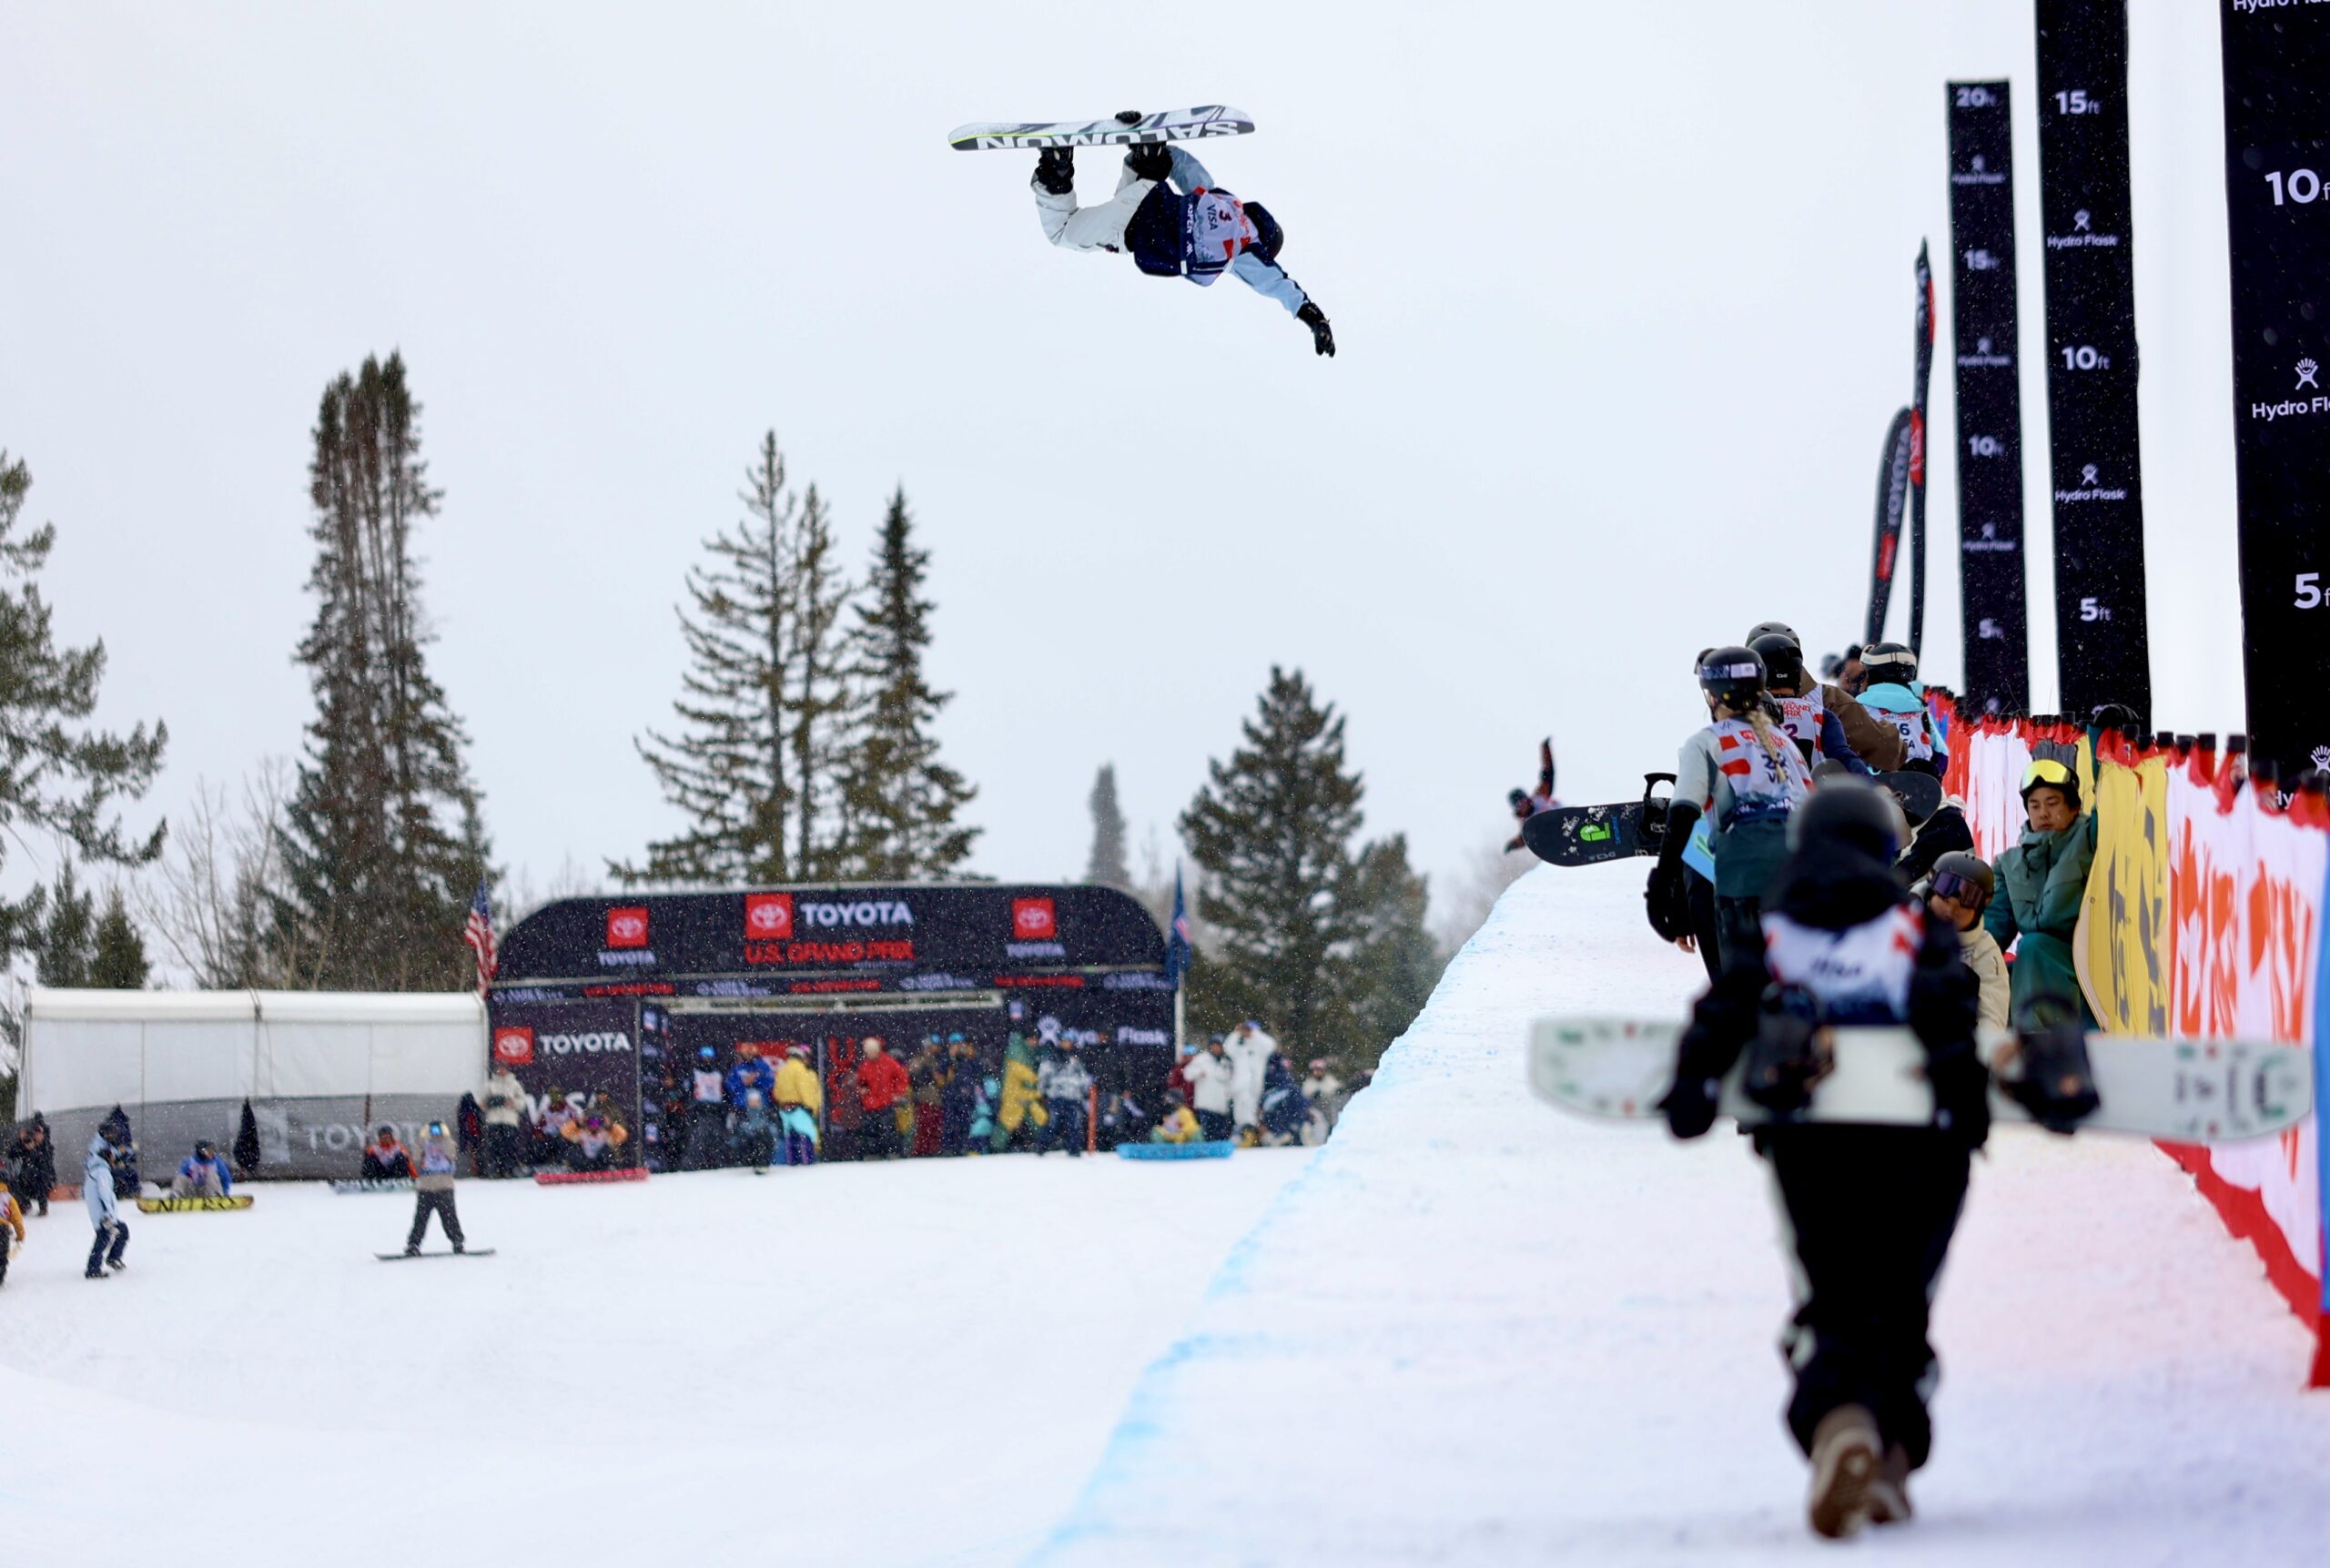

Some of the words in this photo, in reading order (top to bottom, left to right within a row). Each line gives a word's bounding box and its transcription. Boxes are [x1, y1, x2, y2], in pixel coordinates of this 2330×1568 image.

[2055, 89, 2100, 115] 15ft
[977, 122, 1238, 149] SALOMON
[1207, 204, 1218, 230] VISA
[2048, 235, 2082, 249] Hydro
[2084, 234, 2118, 246] Flask
[2062, 346, 2111, 370] 10ft
[2252, 400, 2308, 421] Hydro
[2055, 490, 2091, 503] Hydro
[2092, 488, 2126, 501] Flask
[2080, 597, 2112, 622] 5ft
[799, 901, 915, 926] TOYOTA
[598, 950, 656, 967] TOYOTA
[539, 1032, 632, 1056] TOYOTA
[1118, 1026, 1171, 1046] Flask
